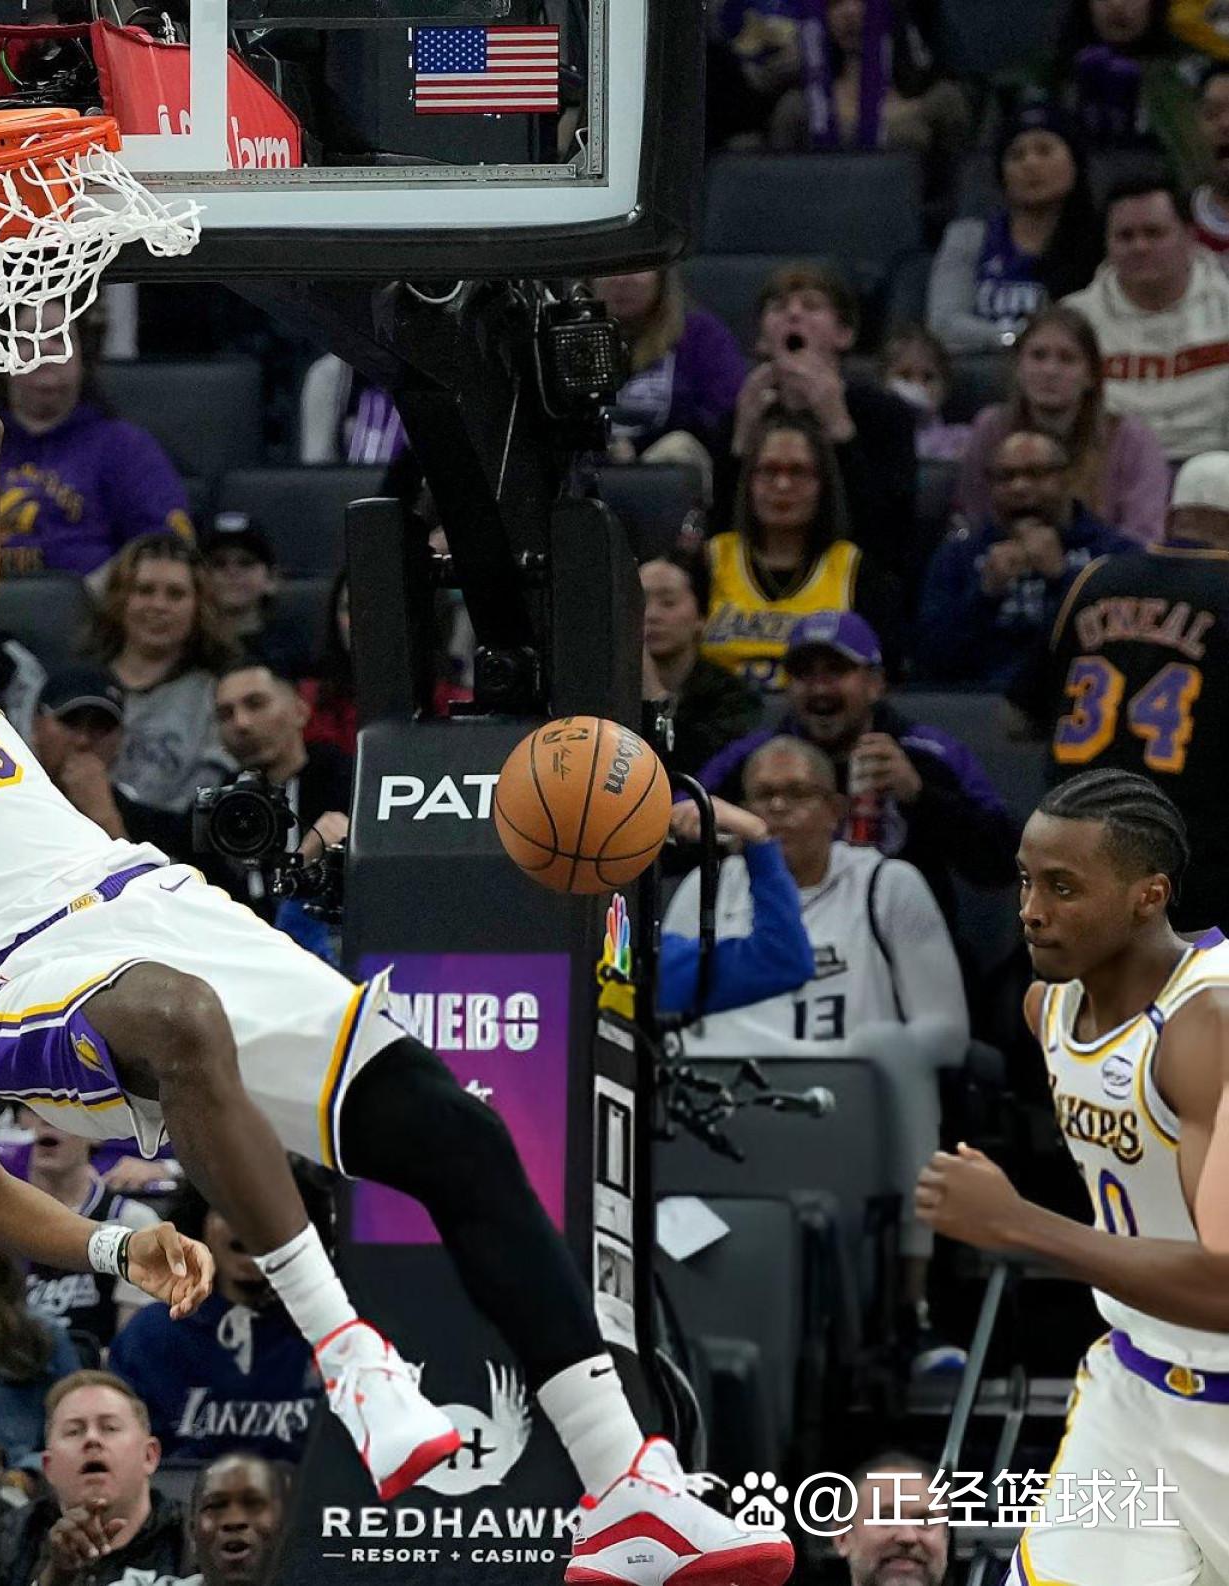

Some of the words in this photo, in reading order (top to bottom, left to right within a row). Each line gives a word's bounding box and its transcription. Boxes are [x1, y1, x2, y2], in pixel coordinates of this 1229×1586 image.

[1051, 654, 1204, 775] 34
[791, 993, 847, 1041] 13
[175, 1386, 316, 1443] LAKERS
[351, 1548, 440, 1563] RESORT
[470, 1548, 556, 1563] CASINO
